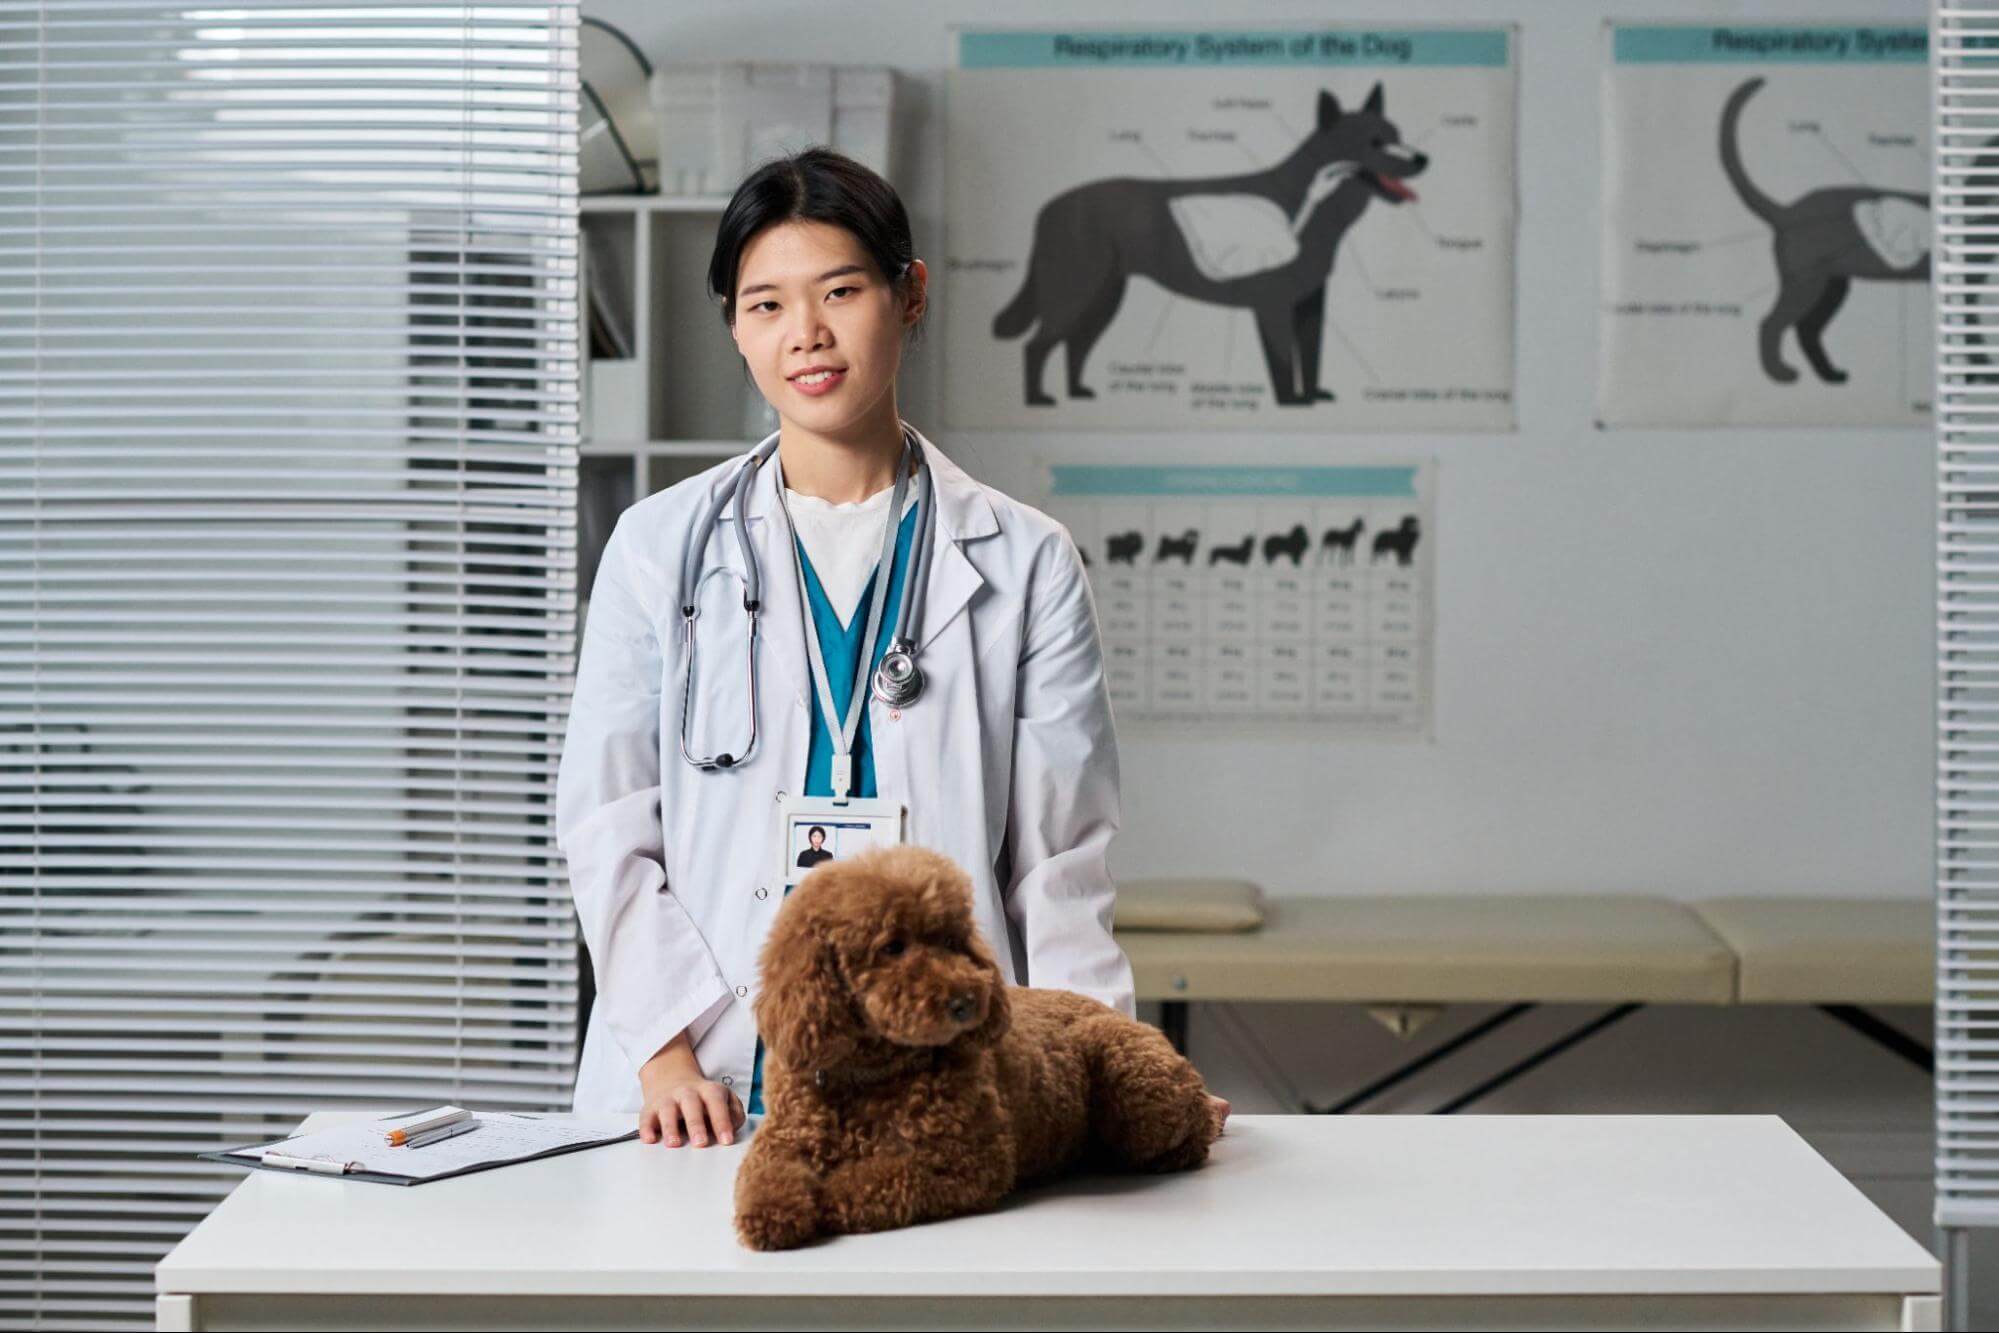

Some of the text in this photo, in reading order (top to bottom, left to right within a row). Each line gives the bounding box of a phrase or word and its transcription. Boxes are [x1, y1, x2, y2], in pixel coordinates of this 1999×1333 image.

[1053, 33, 1412, 64] Respiratory System of the Dog
[1711, 28, 1849, 57] Respiratory
